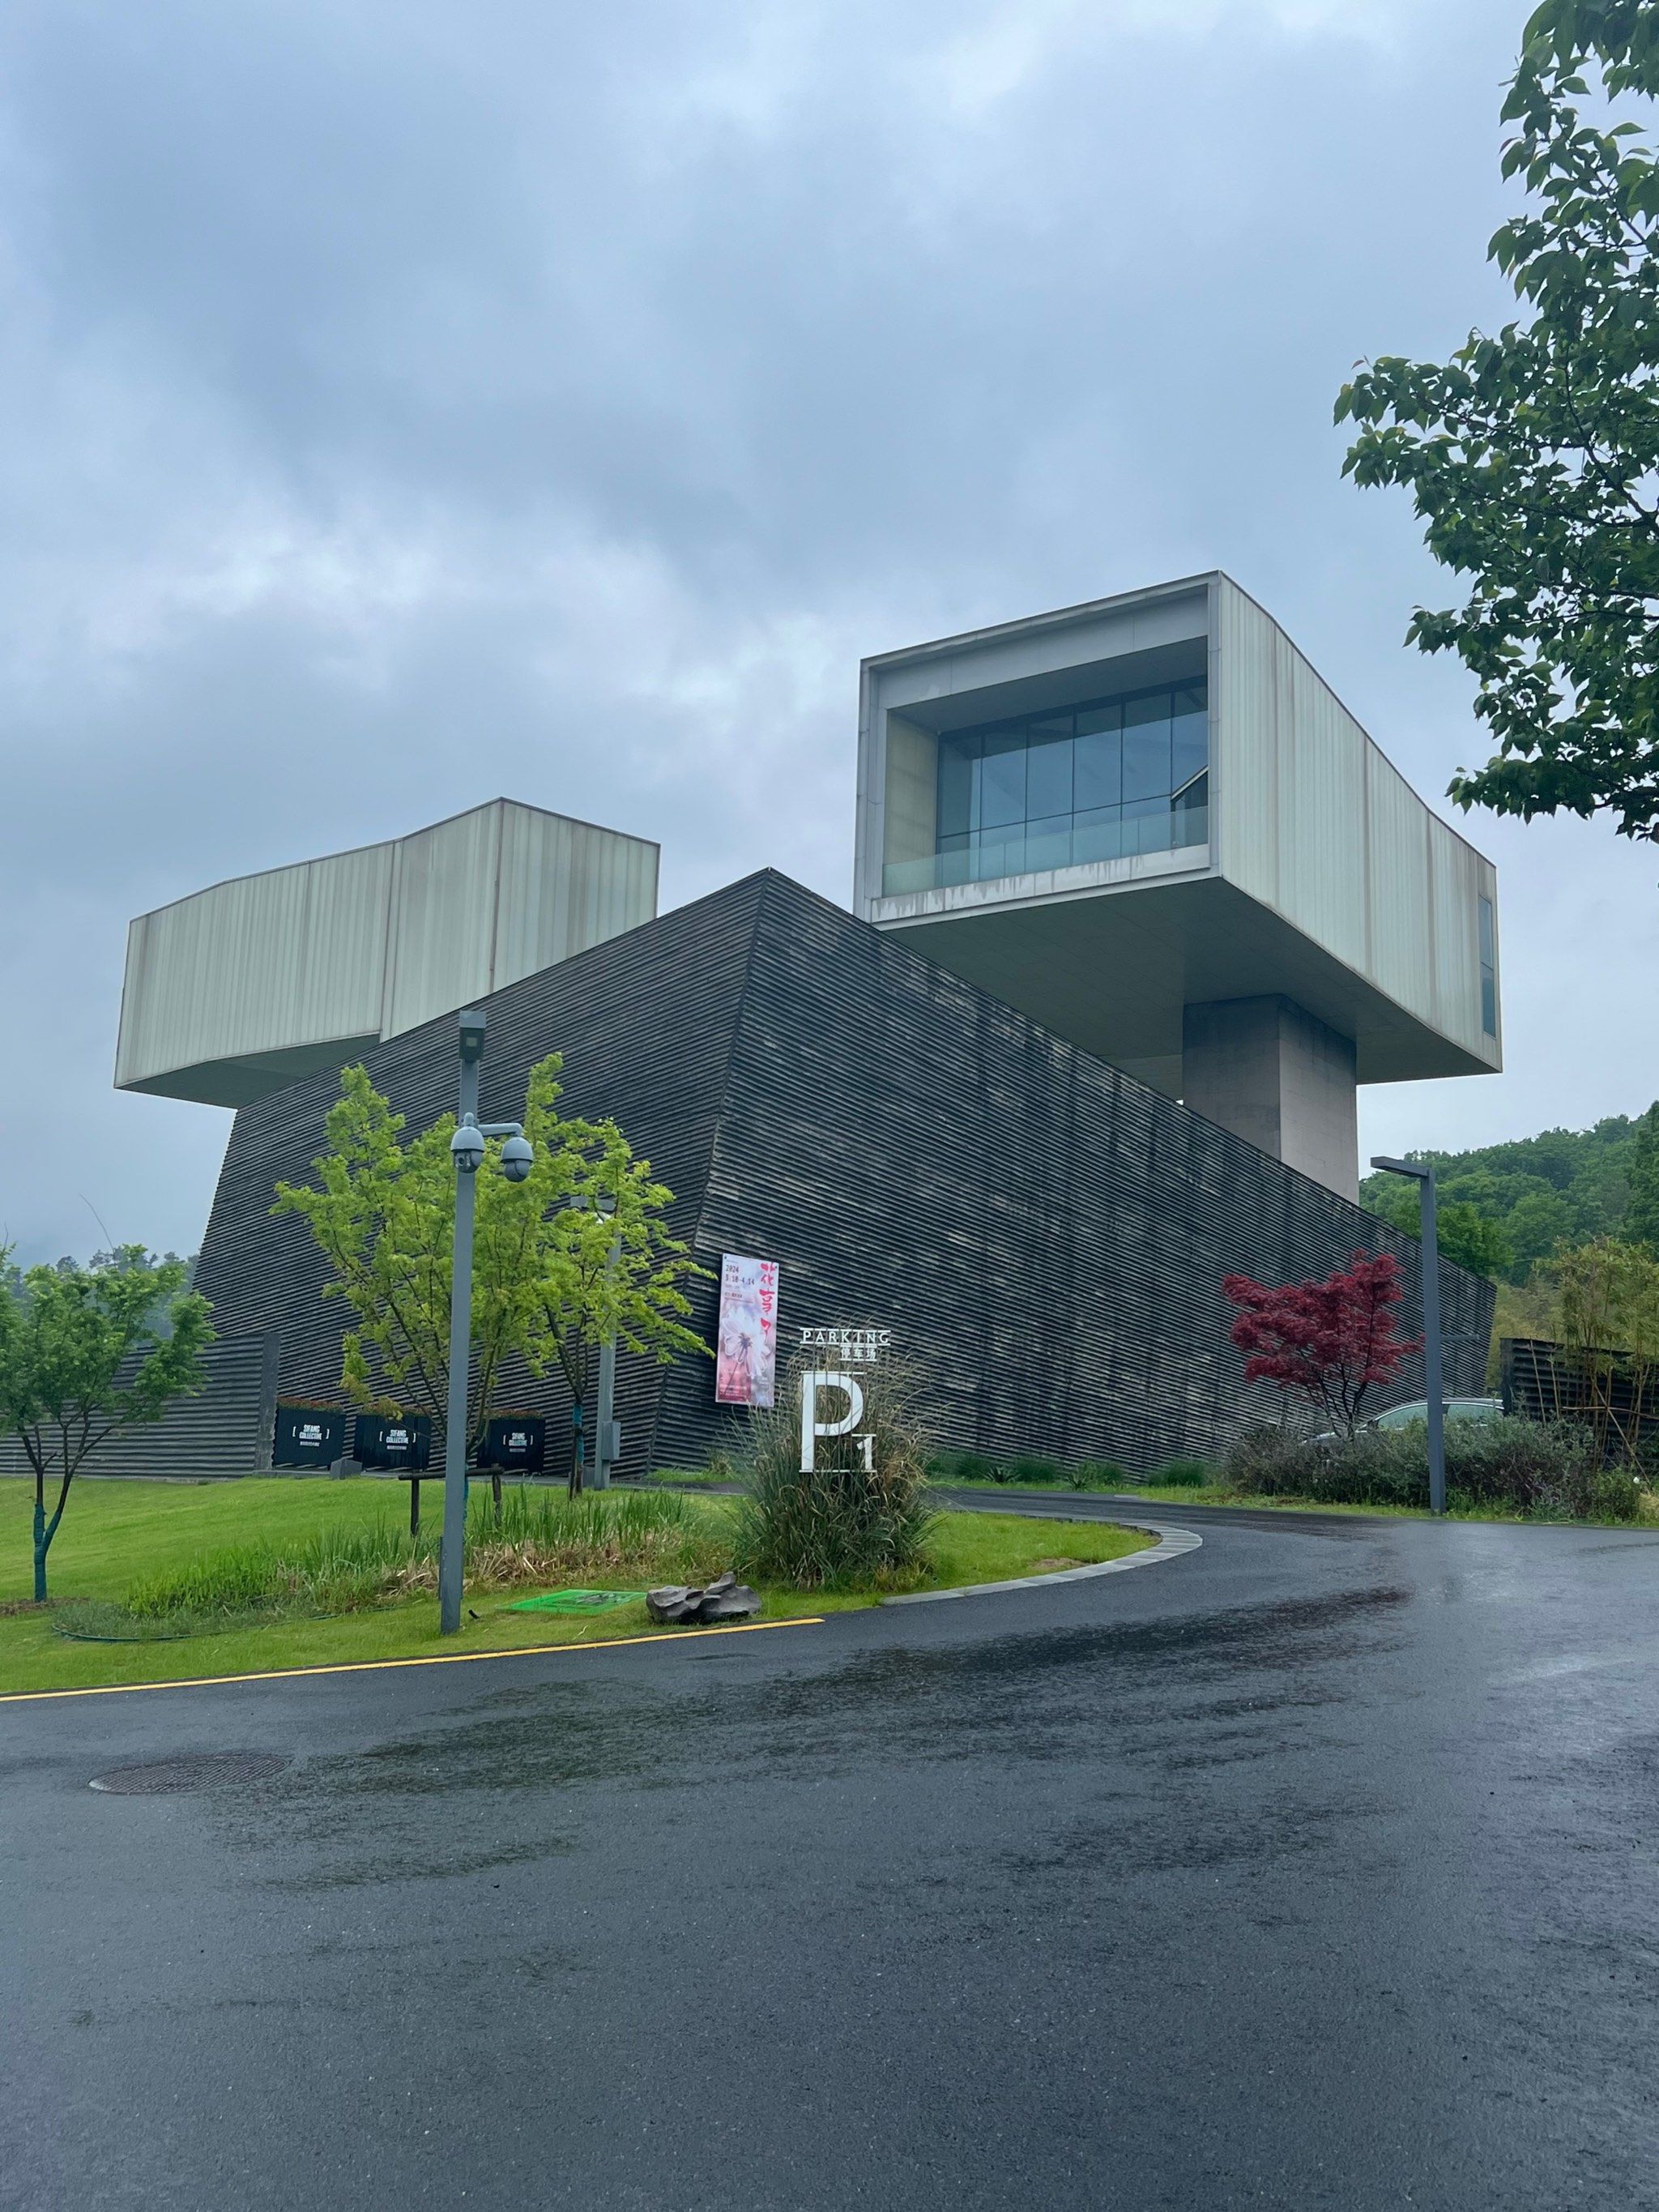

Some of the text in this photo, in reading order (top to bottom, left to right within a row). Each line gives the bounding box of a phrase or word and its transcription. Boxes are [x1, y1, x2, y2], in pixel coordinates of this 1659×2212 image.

[726, 1264, 739, 1273] 2024
[803, 1330, 889, 1343] PARKING
[841, 1347, 876, 1360] 停车场
